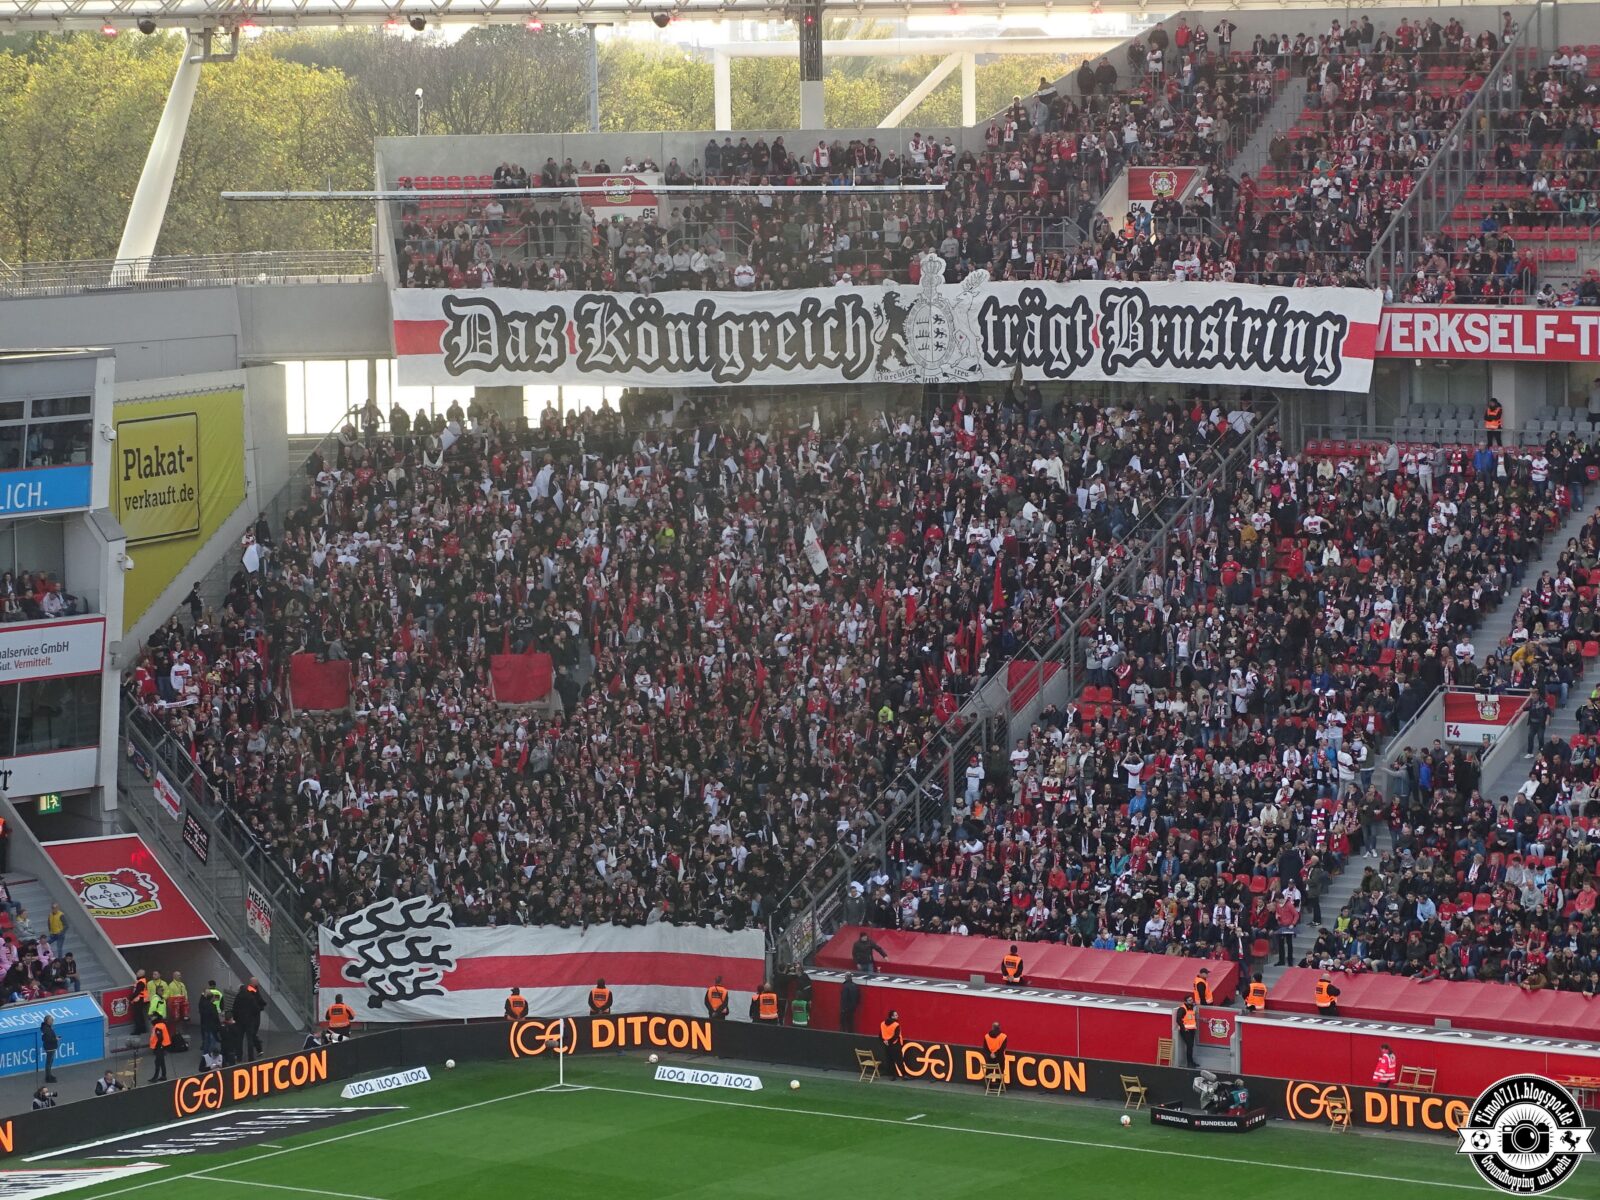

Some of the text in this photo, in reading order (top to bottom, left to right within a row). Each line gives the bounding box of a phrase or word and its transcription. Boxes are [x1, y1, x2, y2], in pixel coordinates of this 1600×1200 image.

[642, 208, 656, 219] G5
[442, 286, 1349, 386] Das Königreich trägt Brustring
[1376, 312, 1600, 356] ERKSELF-T
[123, 444, 194, 482] Plakat-
[0, 481, 48, 510] ICH.
[124, 483, 195, 511] verkauft.de
[40, 641, 70, 655] GmbH
[14, 656, 53, 669] Vermittelt.
[1446, 724, 1461, 738] F4
[248, 887, 273, 921] HESSEN
[592, 1015, 712, 1051] DITCON
[233, 1050, 327, 1100] DITCON
[402, 1069, 428, 1084] iLOQ
[658, 1067, 752, 1089] iLOQ iLOQ iLOQ
[1160, 1113, 1188, 1124] BUNDESLIGA
[1365, 1091, 1470, 1133] DITCO
